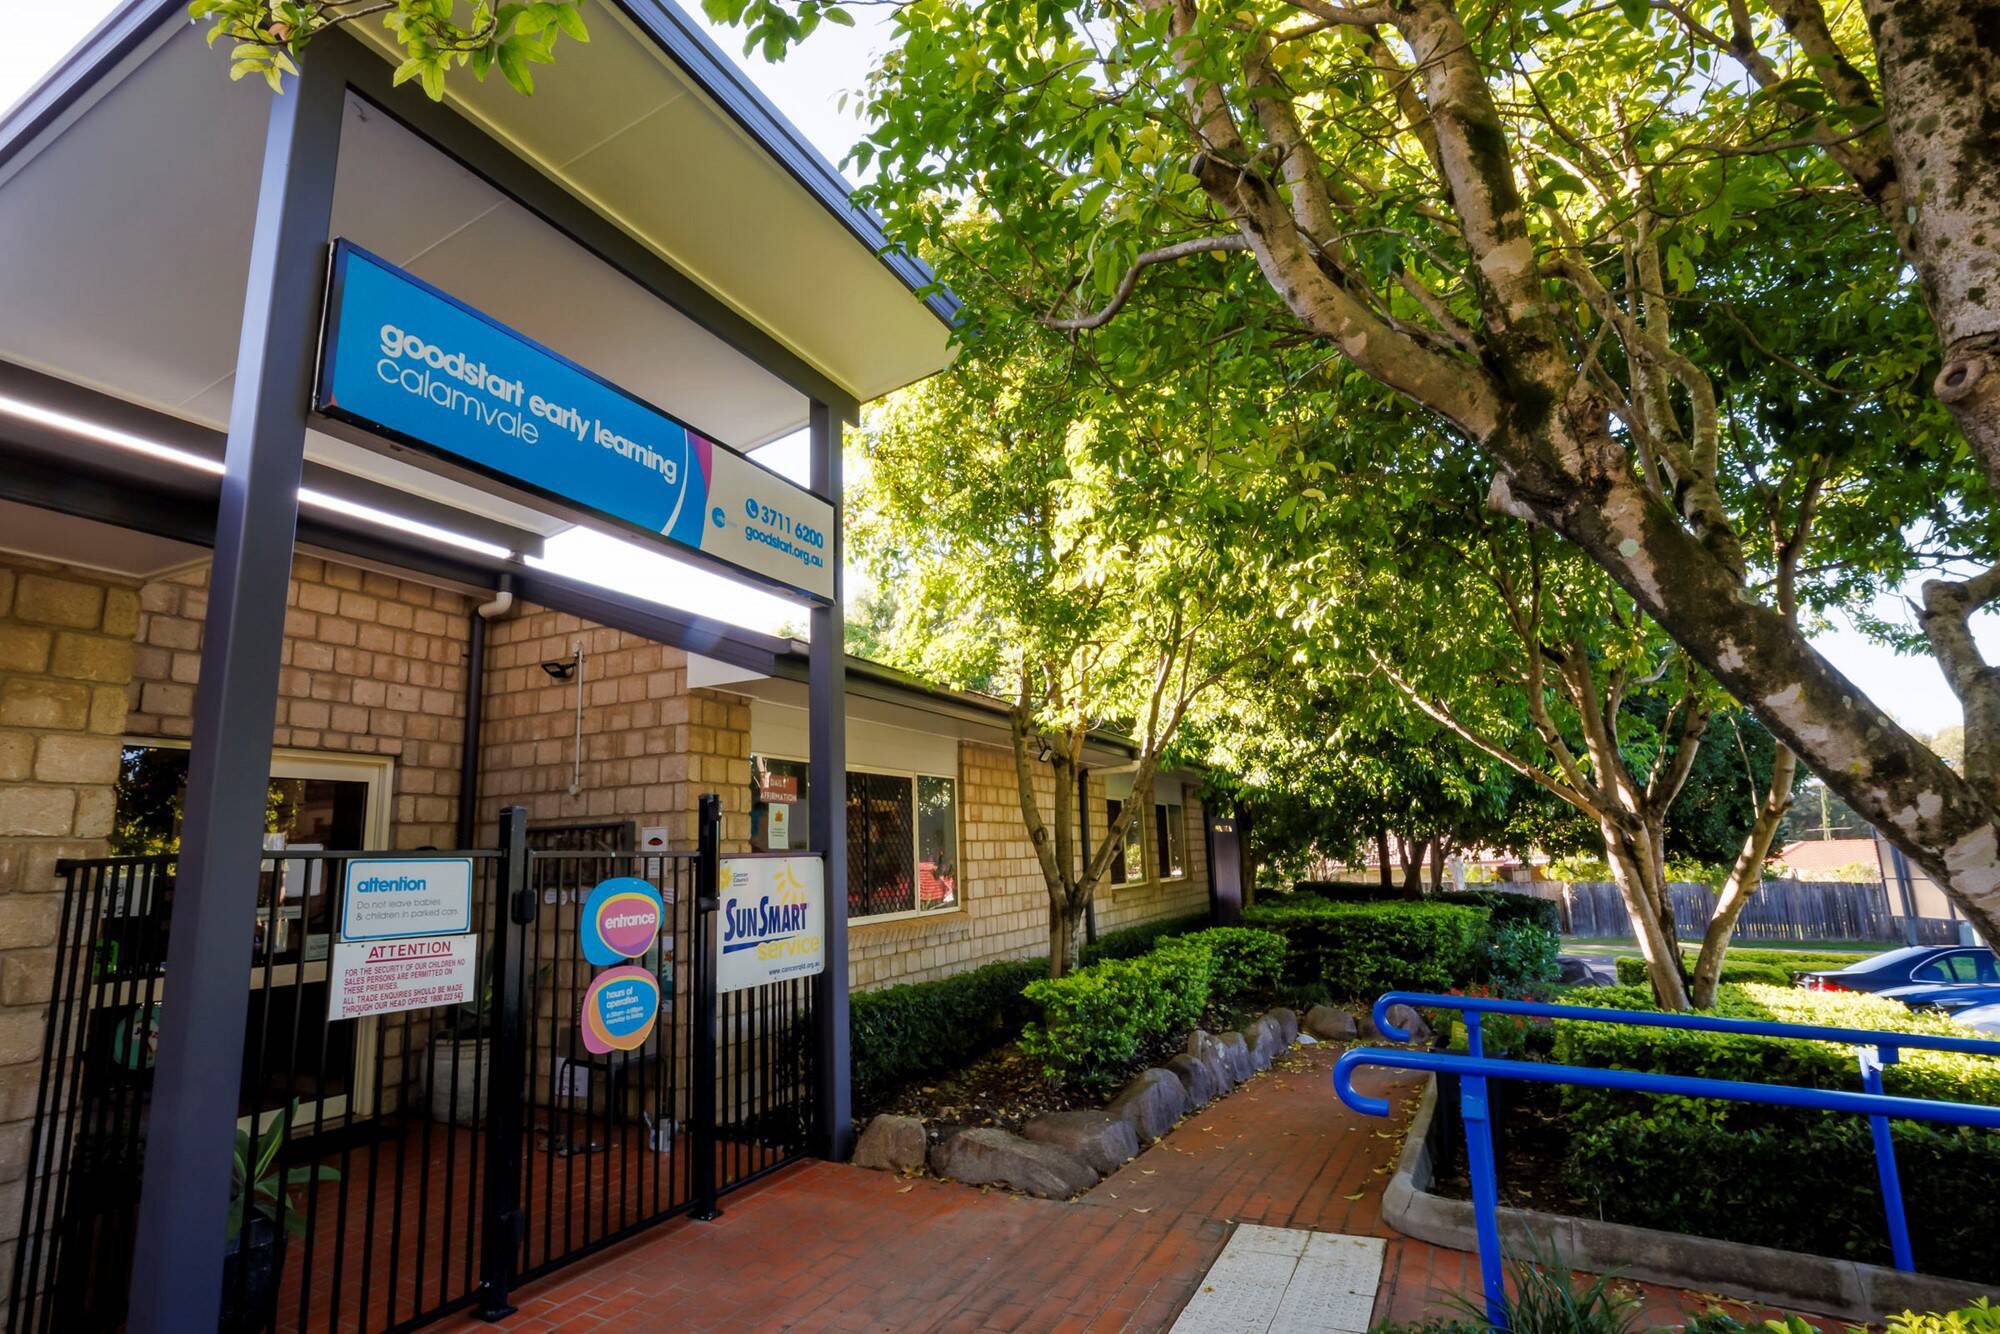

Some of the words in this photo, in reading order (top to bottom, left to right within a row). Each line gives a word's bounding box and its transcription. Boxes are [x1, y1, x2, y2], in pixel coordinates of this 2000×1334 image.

[376, 358, 539, 444] calamvale
[380, 324, 525, 407] goodstart
[529, 394, 590, 442] early
[594, 419, 677, 485] learning
[761, 505, 790, 534] 3711
[795, 522, 823, 549] 6200
[745, 526, 823, 568] goodstart.org.au
[357, 876, 426, 893] attention
[356, 900, 370, 910] Do
[371, 899, 386, 909] not
[388, 899, 412, 909] leave
[365, 911, 400, 921] children
[402, 910, 409, 918] in
[410, 908, 440, 919] parked
[605, 913, 656, 930] entrance
[368, 941, 451, 959] ATTENTION
[757, 934, 820, 961] service
[344, 976, 365, 986] SALES
[366, 973, 396, 983] PERSONS
[397, 971, 409, 980] ARE
[411, 968, 443, 978] PERMITTED
[444, 967, 453, 976] ON
[345, 969, 358, 977] FOR
[360, 967, 372, 976] THE
[374, 964, 404, 975] SECURITY
[415, 962, 427, 970] OUR
[428, 959, 456, 969] CHILDREN
[457, 958, 465, 966] NO
[343, 996, 355, 1005] ALL
[357, 994, 378, 1003] TRADE
[380, 989, 412, 1000] ENQUIRIES
[413, 986, 436, 997] SHOULD
[437, 985, 445, 993] BE
[446, 983, 463, 992] MADE
[344, 985, 364, 995] THESE
[606, 989, 625, 1000] hours
[626, 985, 633, 996] of
[342, 1002, 373, 1014] THROUGH
[374, 1001, 388, 1010] OUR
[389, 998, 407, 1007] HEAD
[408, 995, 428, 1005] OFFICE
[606, 996, 639, 1010] operation
